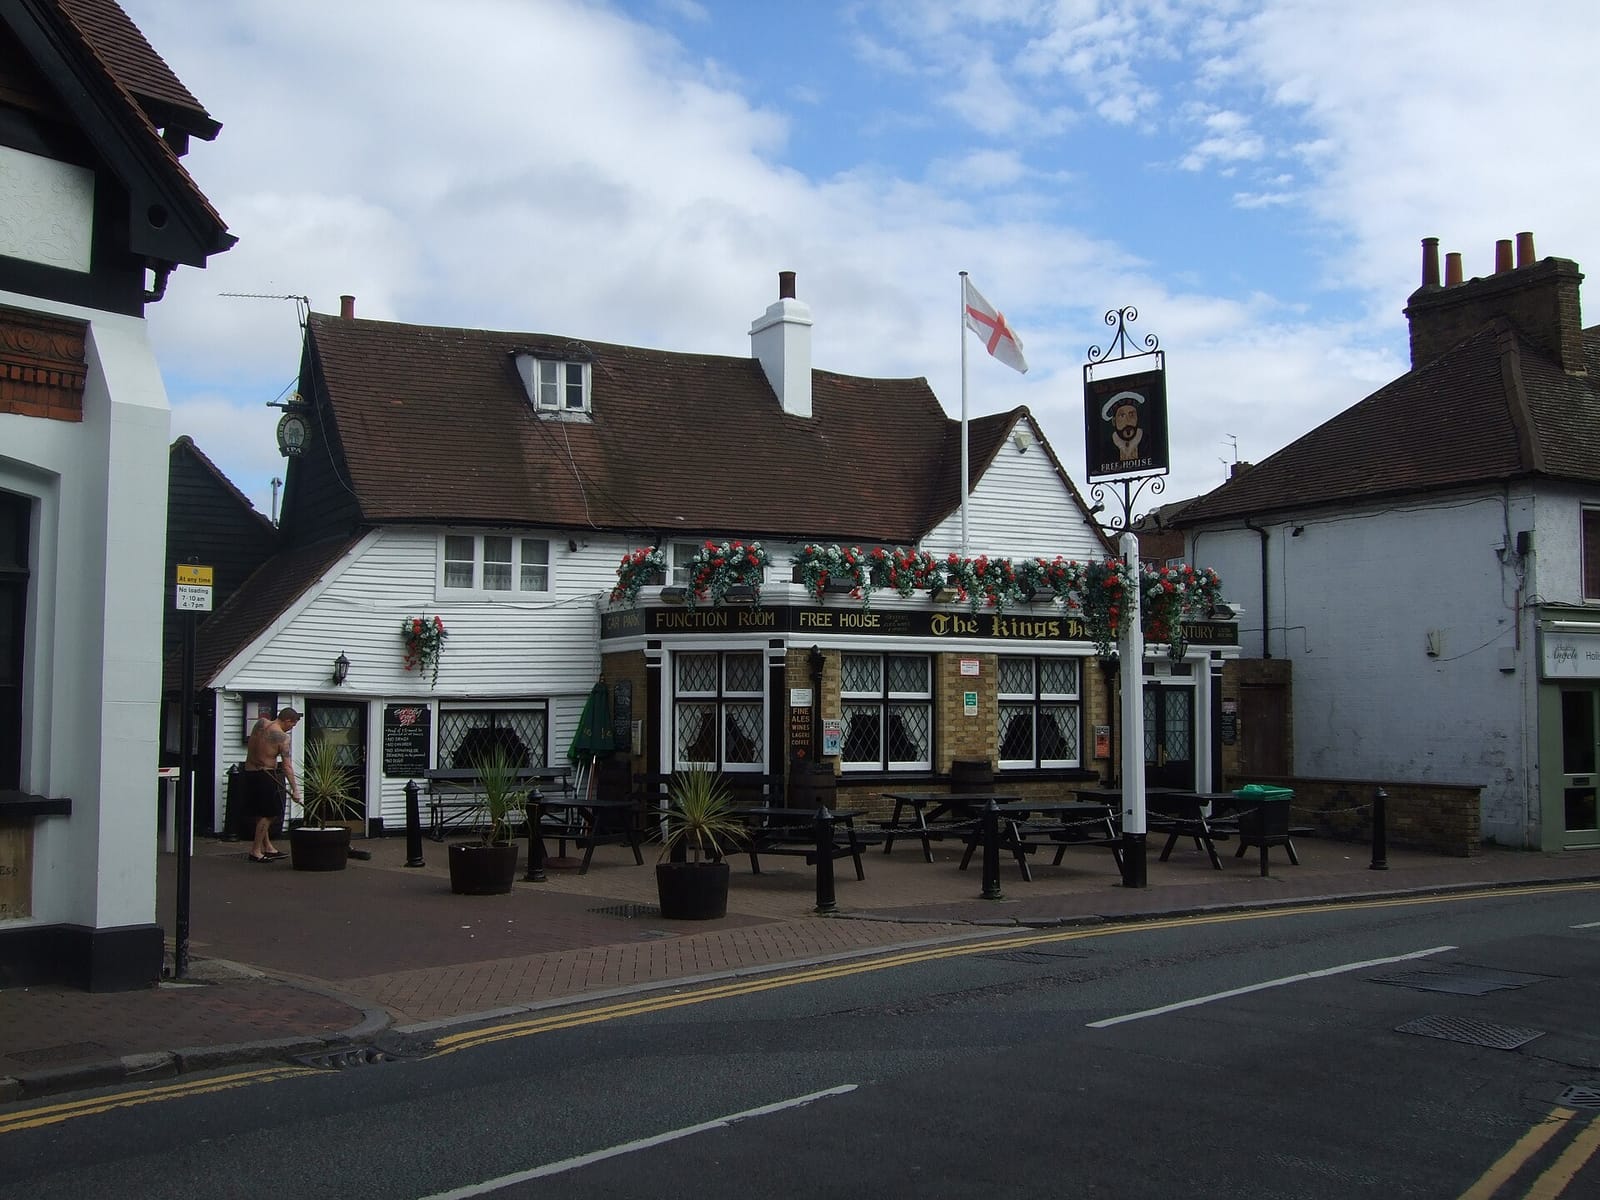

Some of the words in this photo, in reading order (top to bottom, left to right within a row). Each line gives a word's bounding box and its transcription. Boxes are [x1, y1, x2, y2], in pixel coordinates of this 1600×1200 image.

[1123, 458, 1153, 468] HOUSE
[656, 612, 727, 628] FUNCTION
[738, 611, 775, 626] ROOM
[800, 612, 833, 627] FREE
[840, 613, 880, 628] HOUSE
[931, 613, 979, 636] The
[992, 615, 1060, 638] Kings
